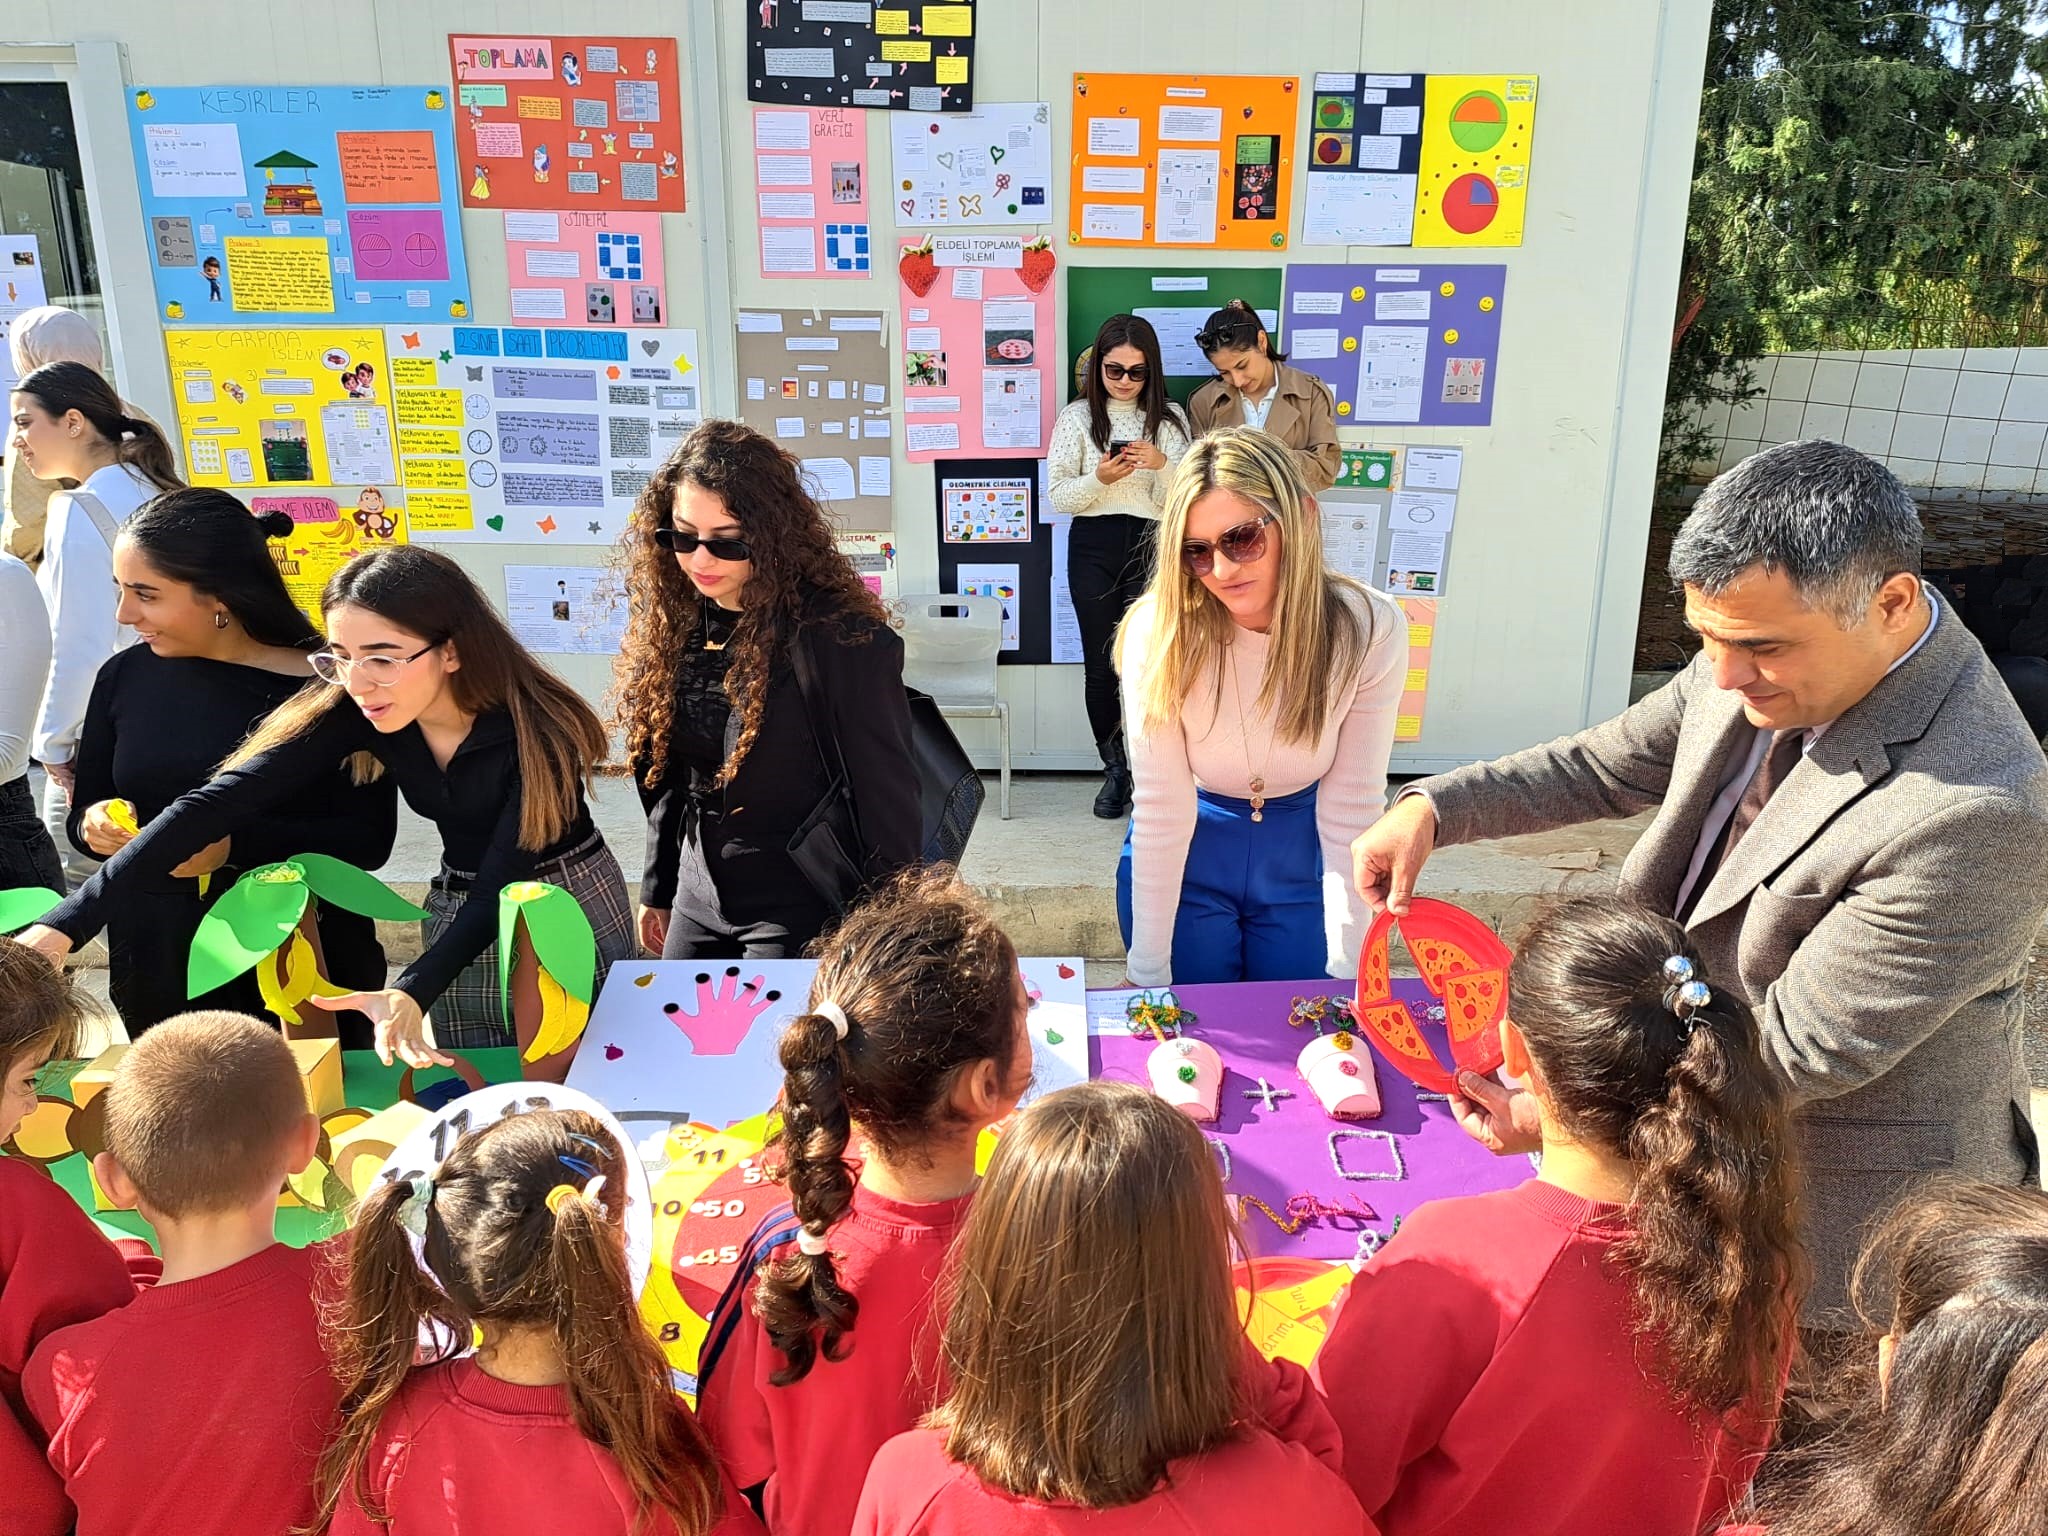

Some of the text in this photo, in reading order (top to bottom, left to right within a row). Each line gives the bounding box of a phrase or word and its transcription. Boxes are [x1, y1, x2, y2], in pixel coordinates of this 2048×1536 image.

[464, 48, 549, 70] TOPLAMA
[936, 238, 1022, 250] ELDELİ TOPLAMA
[962, 251, 996, 264] İŞLEMİ
[693, 1148, 726, 1165] 11
[702, 1200, 745, 1218] 50
[693, 1245, 739, 1265] 45
[659, 1322, 681, 1342] 8
